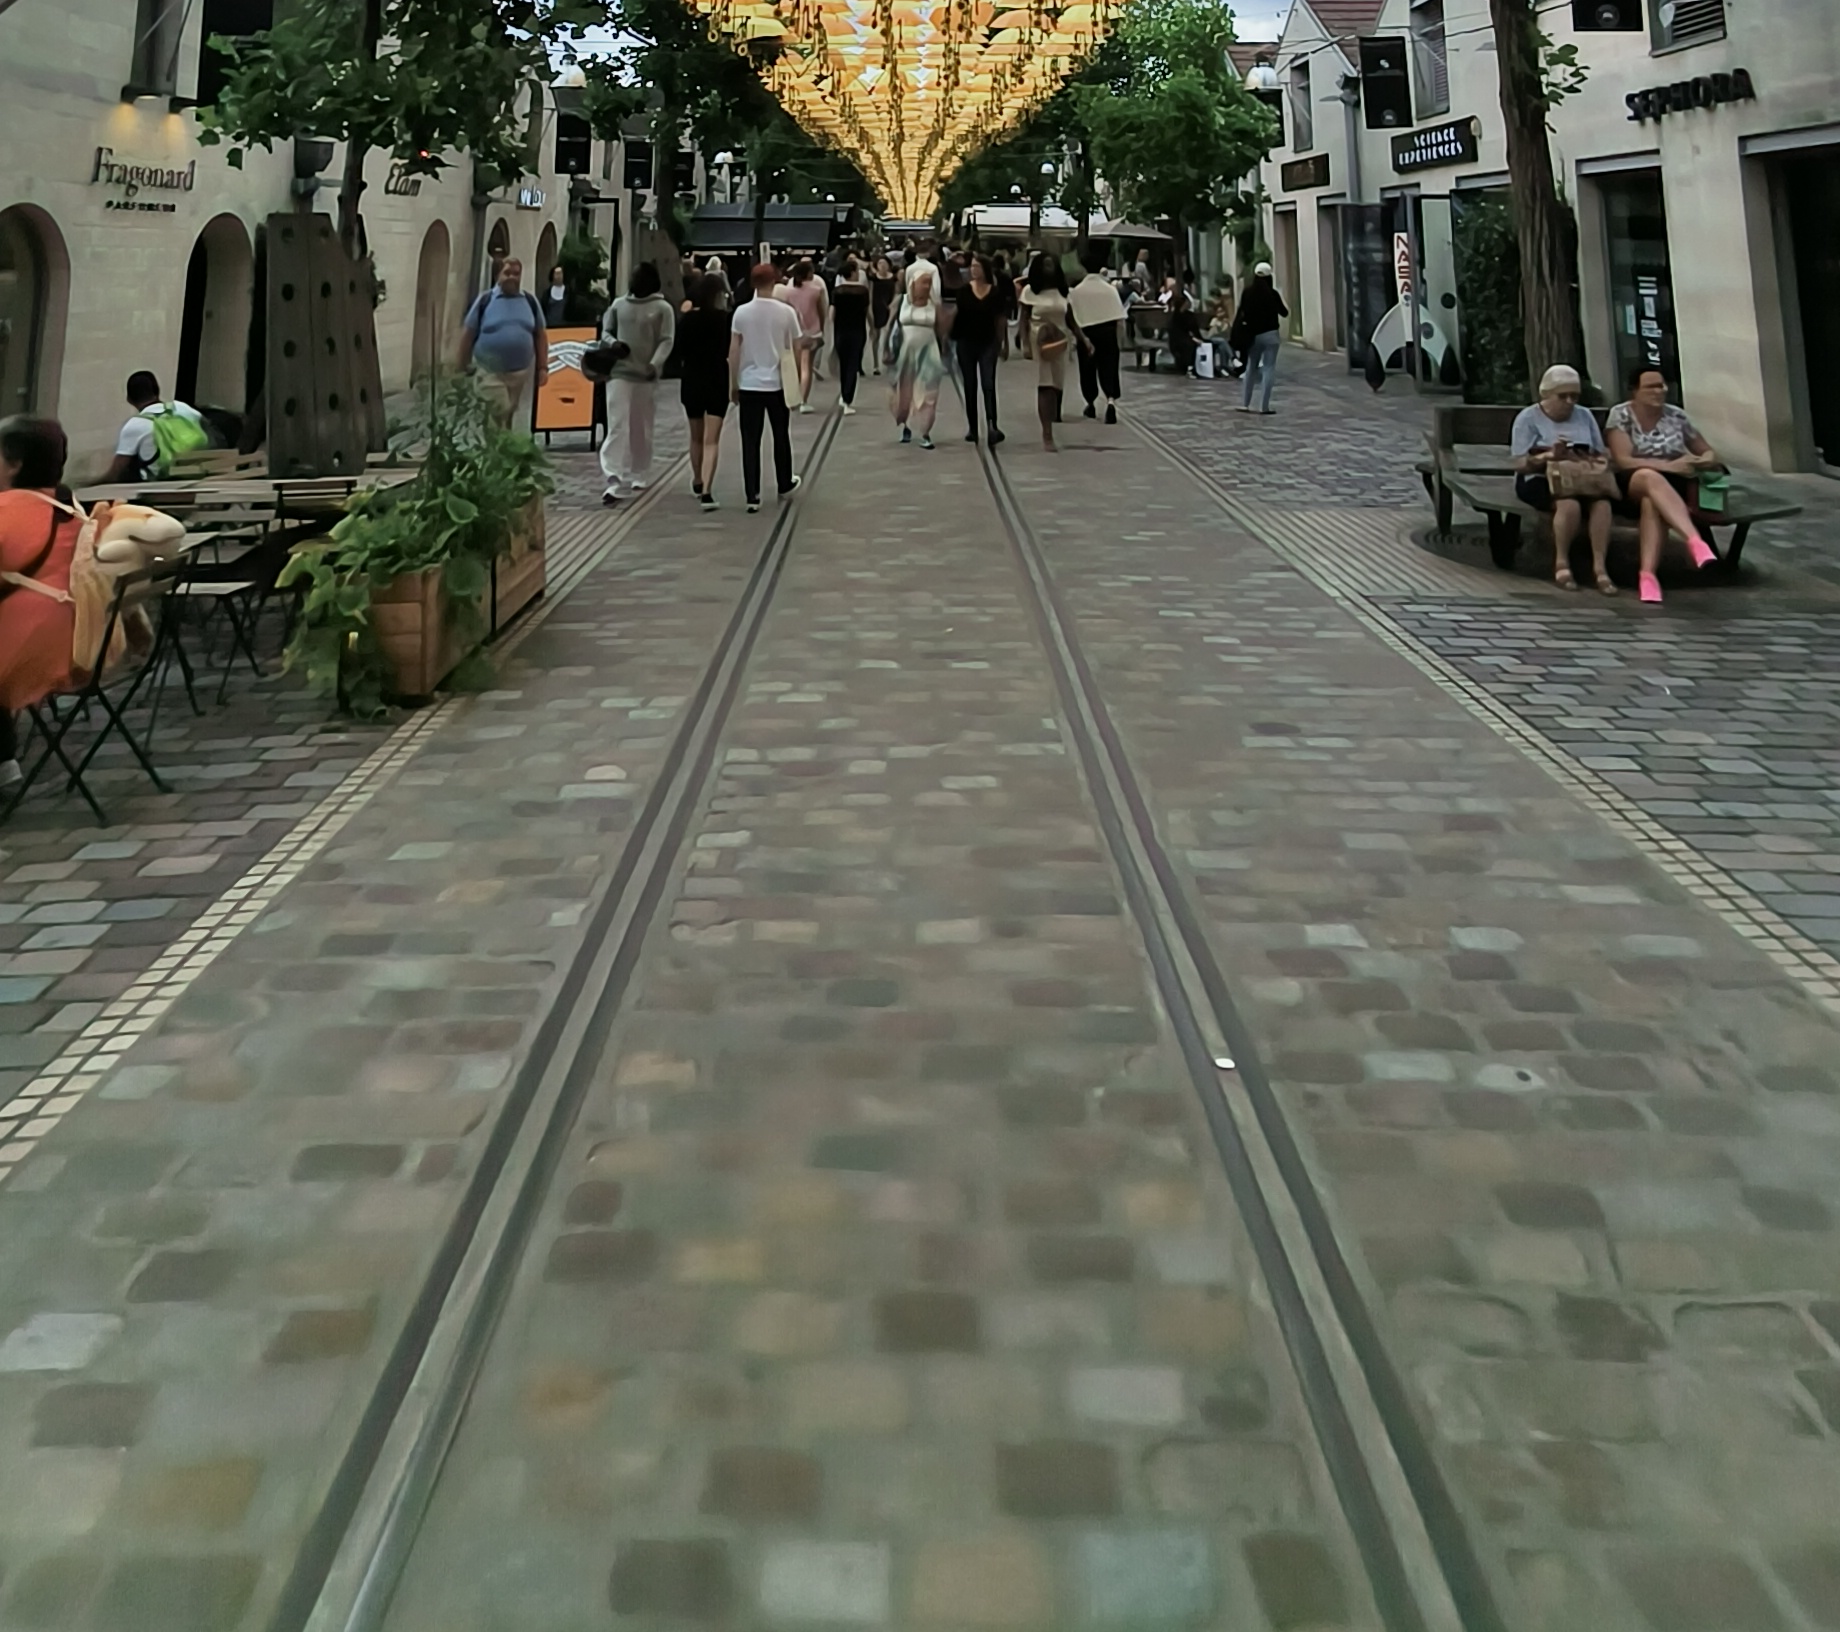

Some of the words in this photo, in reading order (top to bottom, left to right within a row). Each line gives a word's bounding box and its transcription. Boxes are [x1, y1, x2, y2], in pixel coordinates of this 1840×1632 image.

[1625, 68, 1757, 123] SEPHORA
[1413, 127, 1456, 148] SCIENCE
[92, 146, 197, 198] Fragonard
